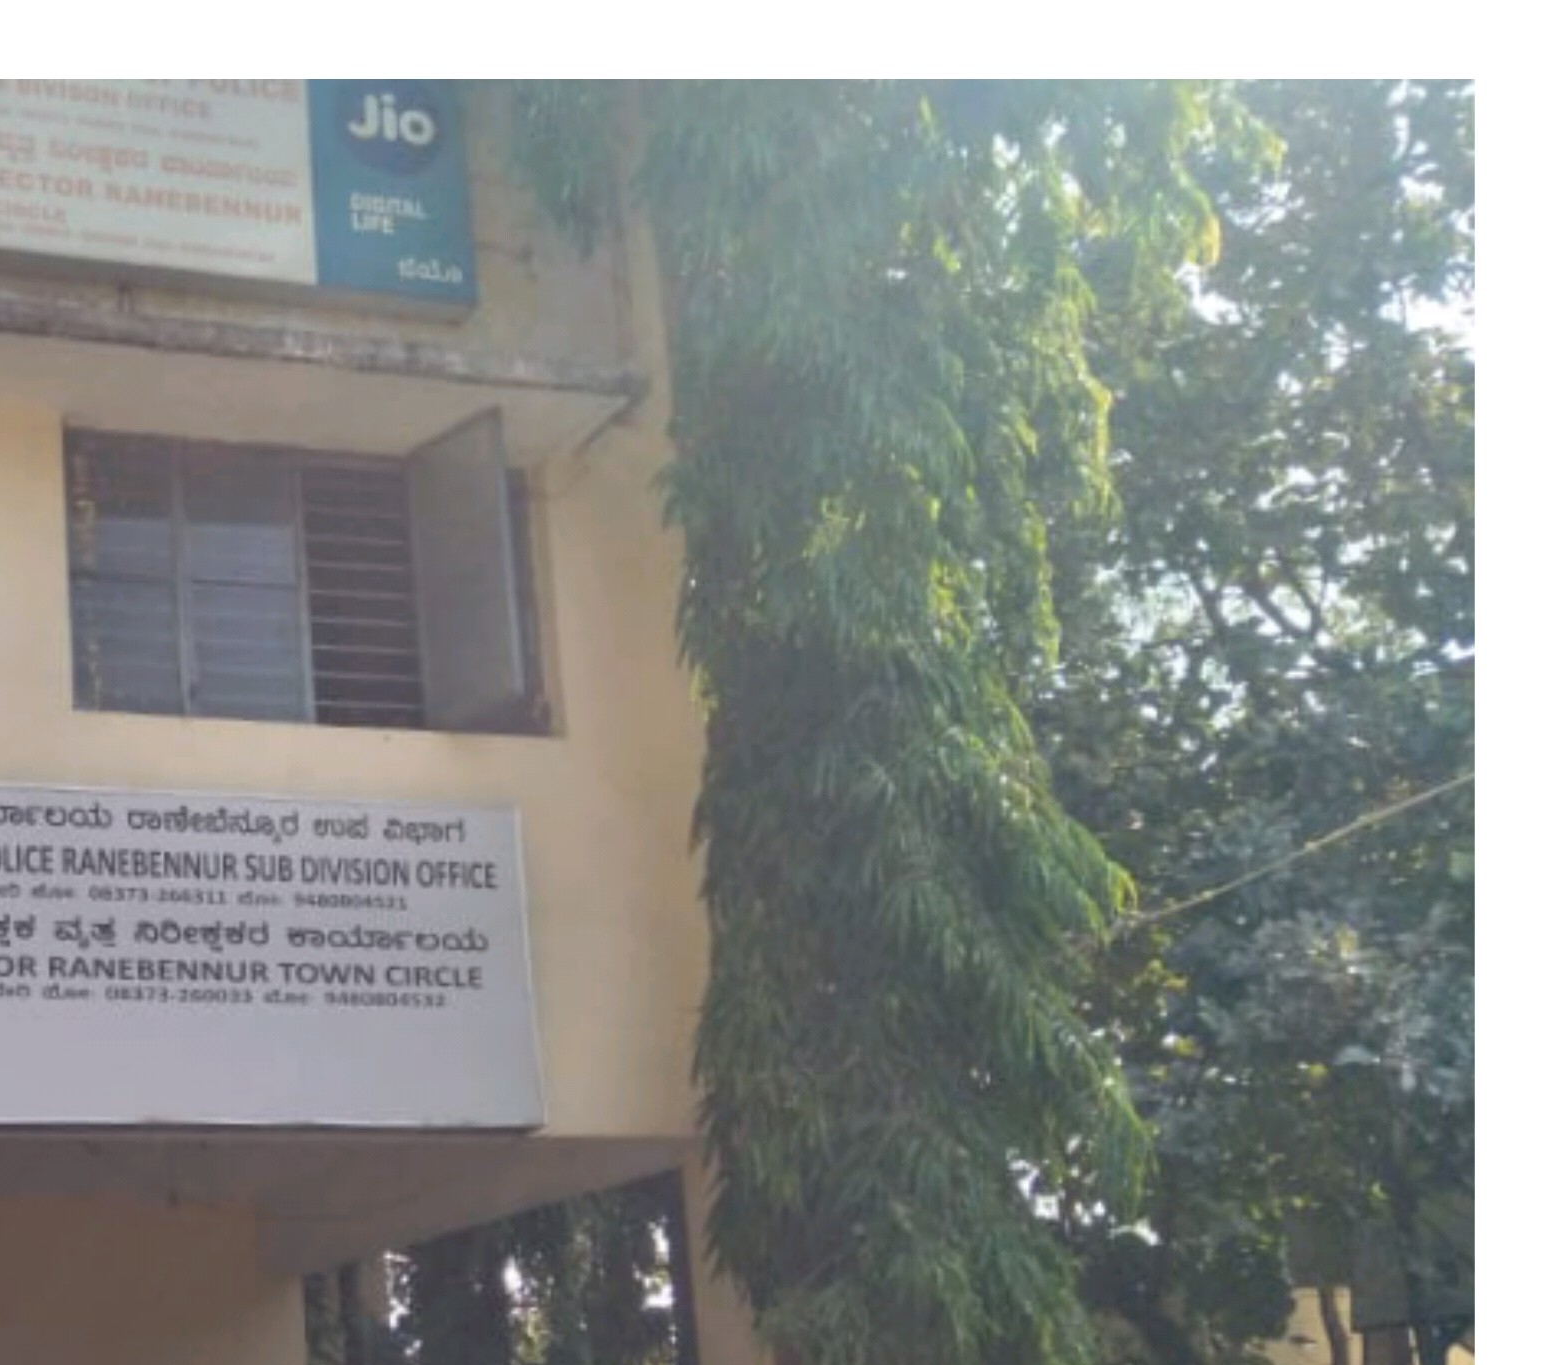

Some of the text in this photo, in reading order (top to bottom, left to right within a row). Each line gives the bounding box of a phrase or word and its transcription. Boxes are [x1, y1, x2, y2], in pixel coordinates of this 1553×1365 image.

[347, 93, 435, 146] Jio
[104, 181, 303, 224] RANEBENNUR
[350, 191, 428, 221] DIGITAL
[351, 212, 395, 234] LIFE
[313, 813, 369, 840] ಉಪ
[62, 848, 239, 882] RANEBENNUR
[246, 854, 294, 883] SUB
[301, 856, 410, 888] DIVISION
[416, 859, 499, 891] OFFICE
[49, 955, 270, 985] RANEBENNUR
[278, 962, 376, 987] TOWN
[385, 964, 484, 990] CIRCLE
